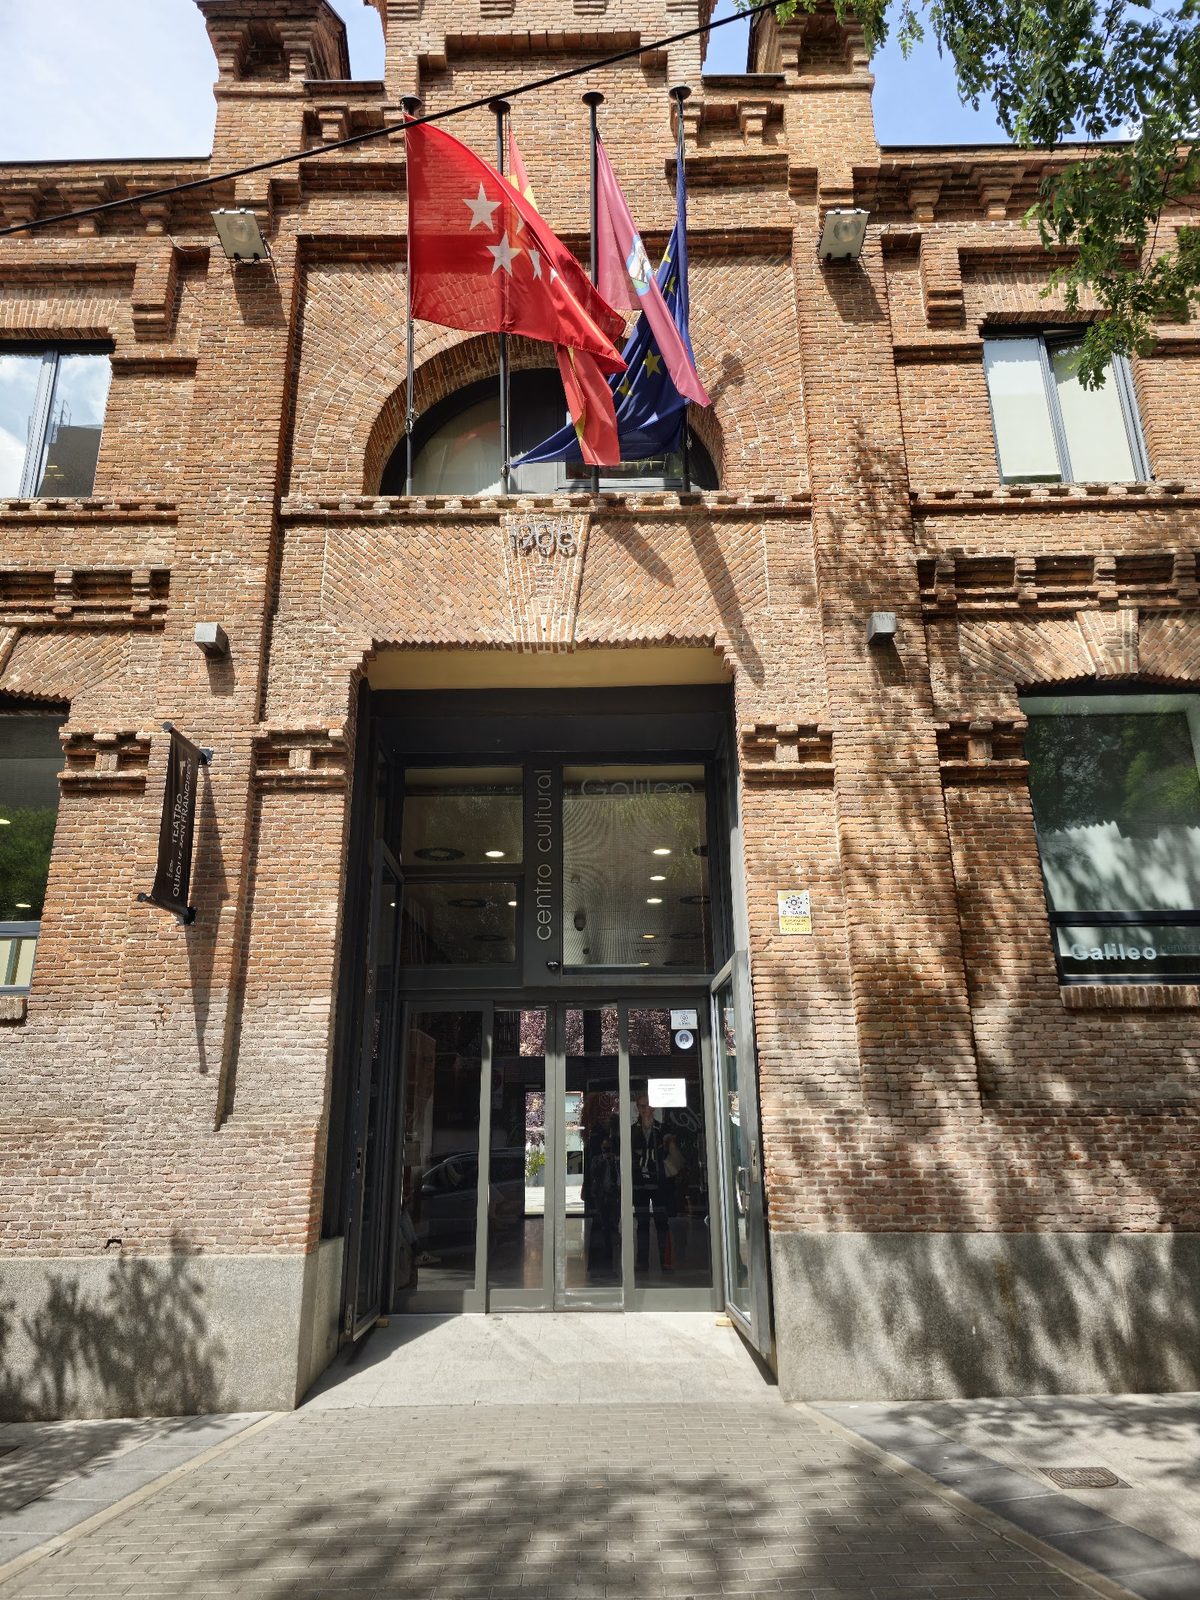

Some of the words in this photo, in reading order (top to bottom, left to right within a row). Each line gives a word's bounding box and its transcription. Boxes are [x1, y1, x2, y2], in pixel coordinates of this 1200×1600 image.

[534, 770, 552, 852] cultural
[581, 776, 696, 797] Galileo
[171, 793, 183, 844] TEATRO
[534, 864, 552, 941] centro
[1071, 943, 1157, 961] Galileo
